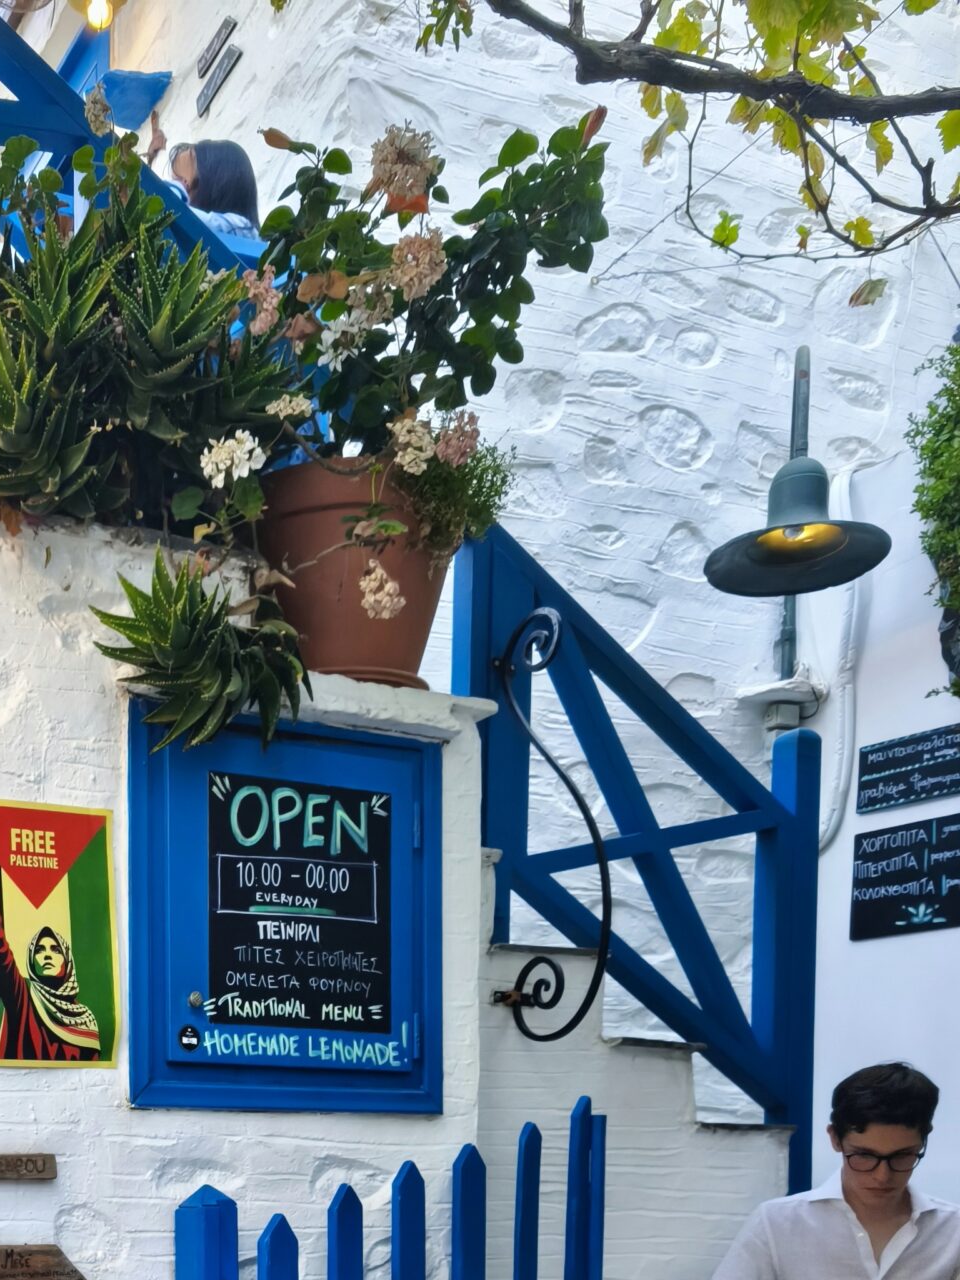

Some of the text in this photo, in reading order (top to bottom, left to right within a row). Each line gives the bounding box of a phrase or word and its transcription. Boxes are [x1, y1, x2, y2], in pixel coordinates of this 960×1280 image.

[230, 785, 369, 857] OPEN
[10, 828, 57, 855] FREE
[858, 828, 929, 855] ΧΟΡΤΟΠΙΤΑ
[9, 853, 60, 870] PALESTINE
[236, 862, 282, 888] 10:00
[305, 863, 350, 894] 00:00
[225, 971, 372, 999] ΟΜΕΛΕΤΑ ΦΟΥΡΝΟΥ
[218, 992, 364, 1023] TRADITIONAL MENU
[203, 1029, 300, 1058] HOMEMADE
